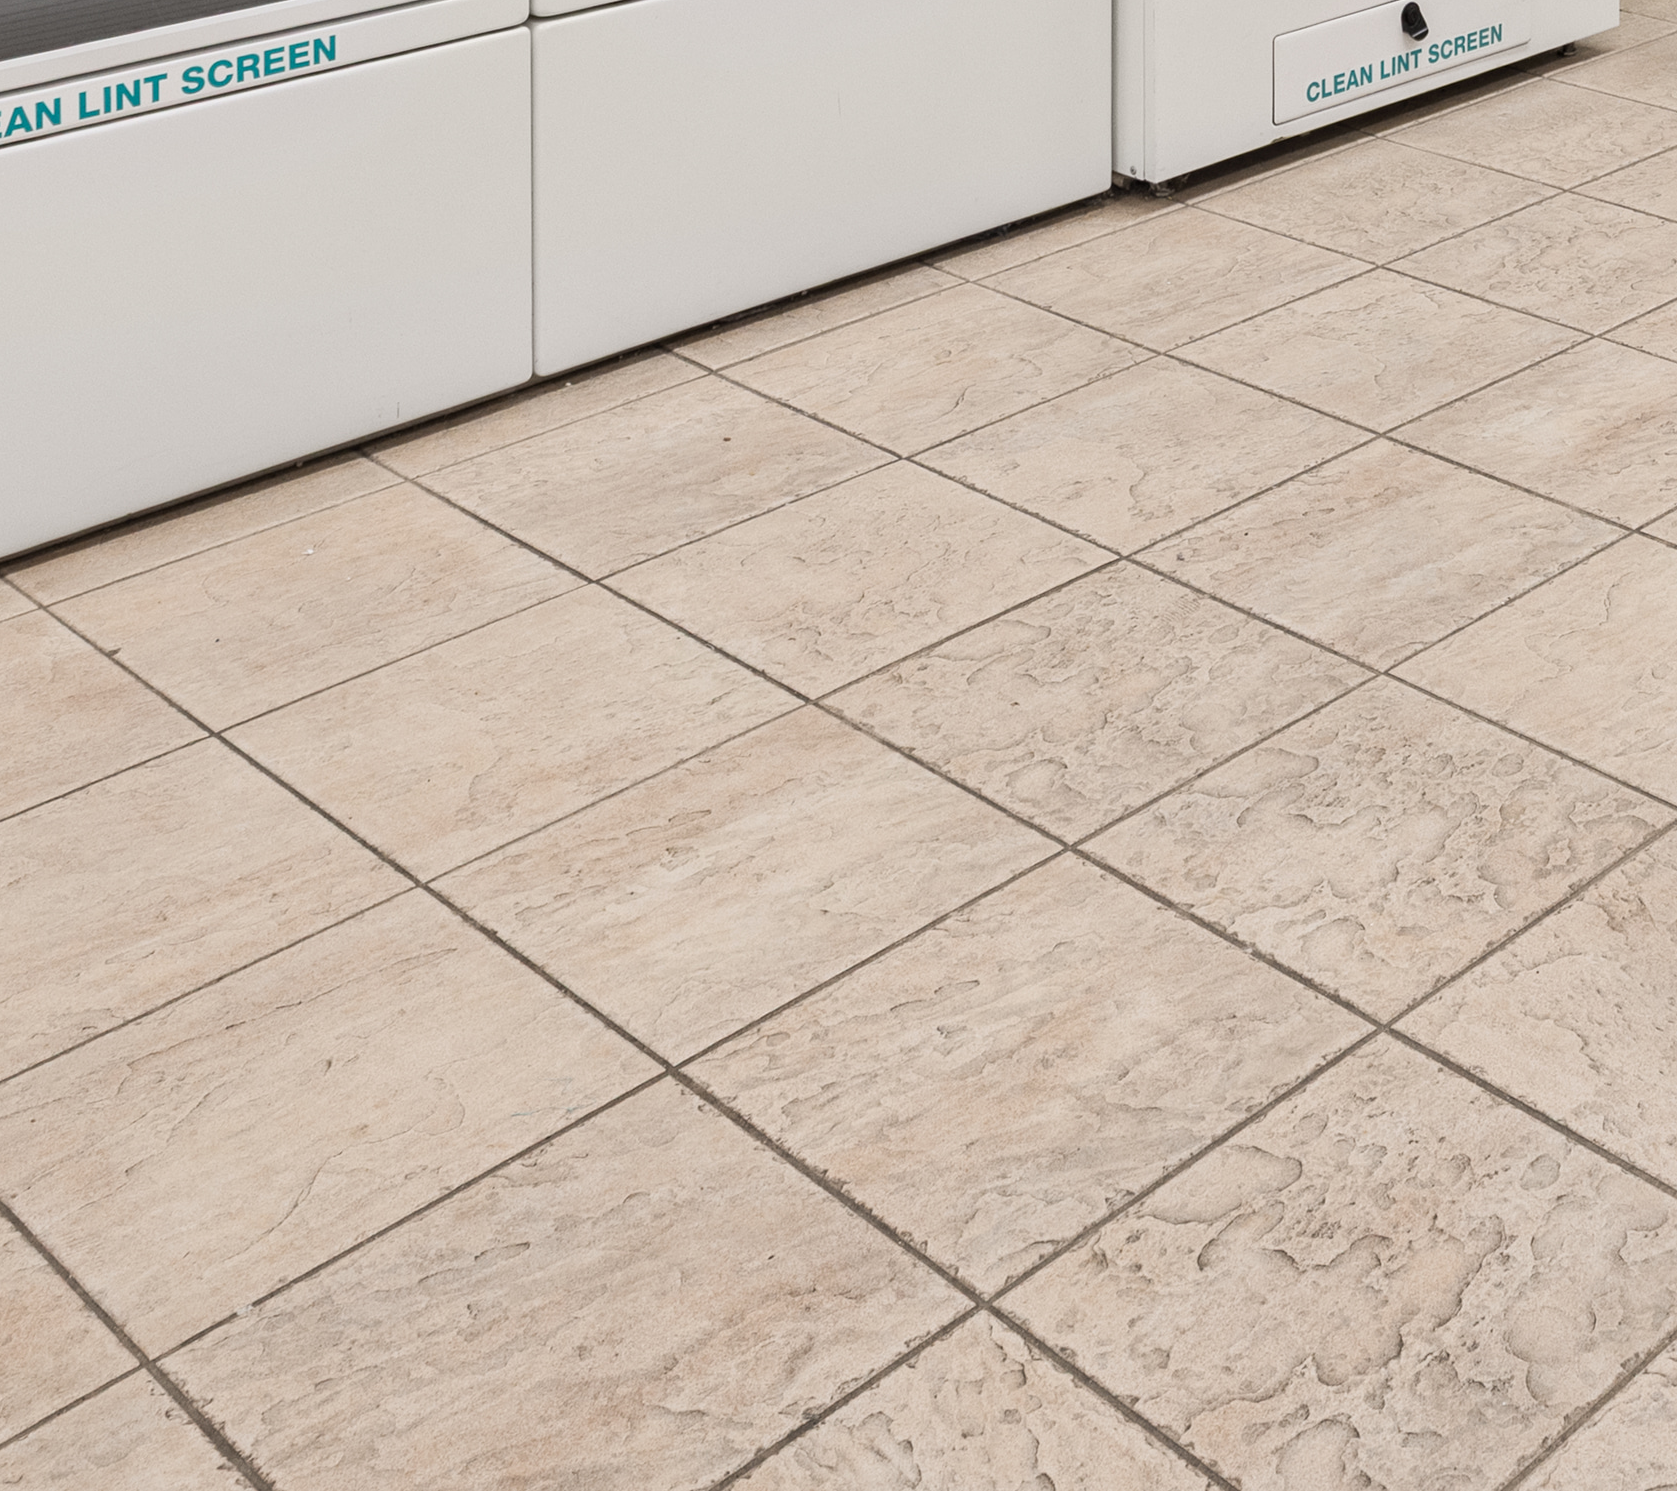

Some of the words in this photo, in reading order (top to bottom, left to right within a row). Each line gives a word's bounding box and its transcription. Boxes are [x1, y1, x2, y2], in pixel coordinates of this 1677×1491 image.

[78, 73, 169, 120] LINT
[182, 35, 339, 95] SCREEN
[1306, 64, 1373, 102] CLEAN
[1380, 49, 1422, 80] LINT
[1428, 23, 1503, 64] SCREEN
